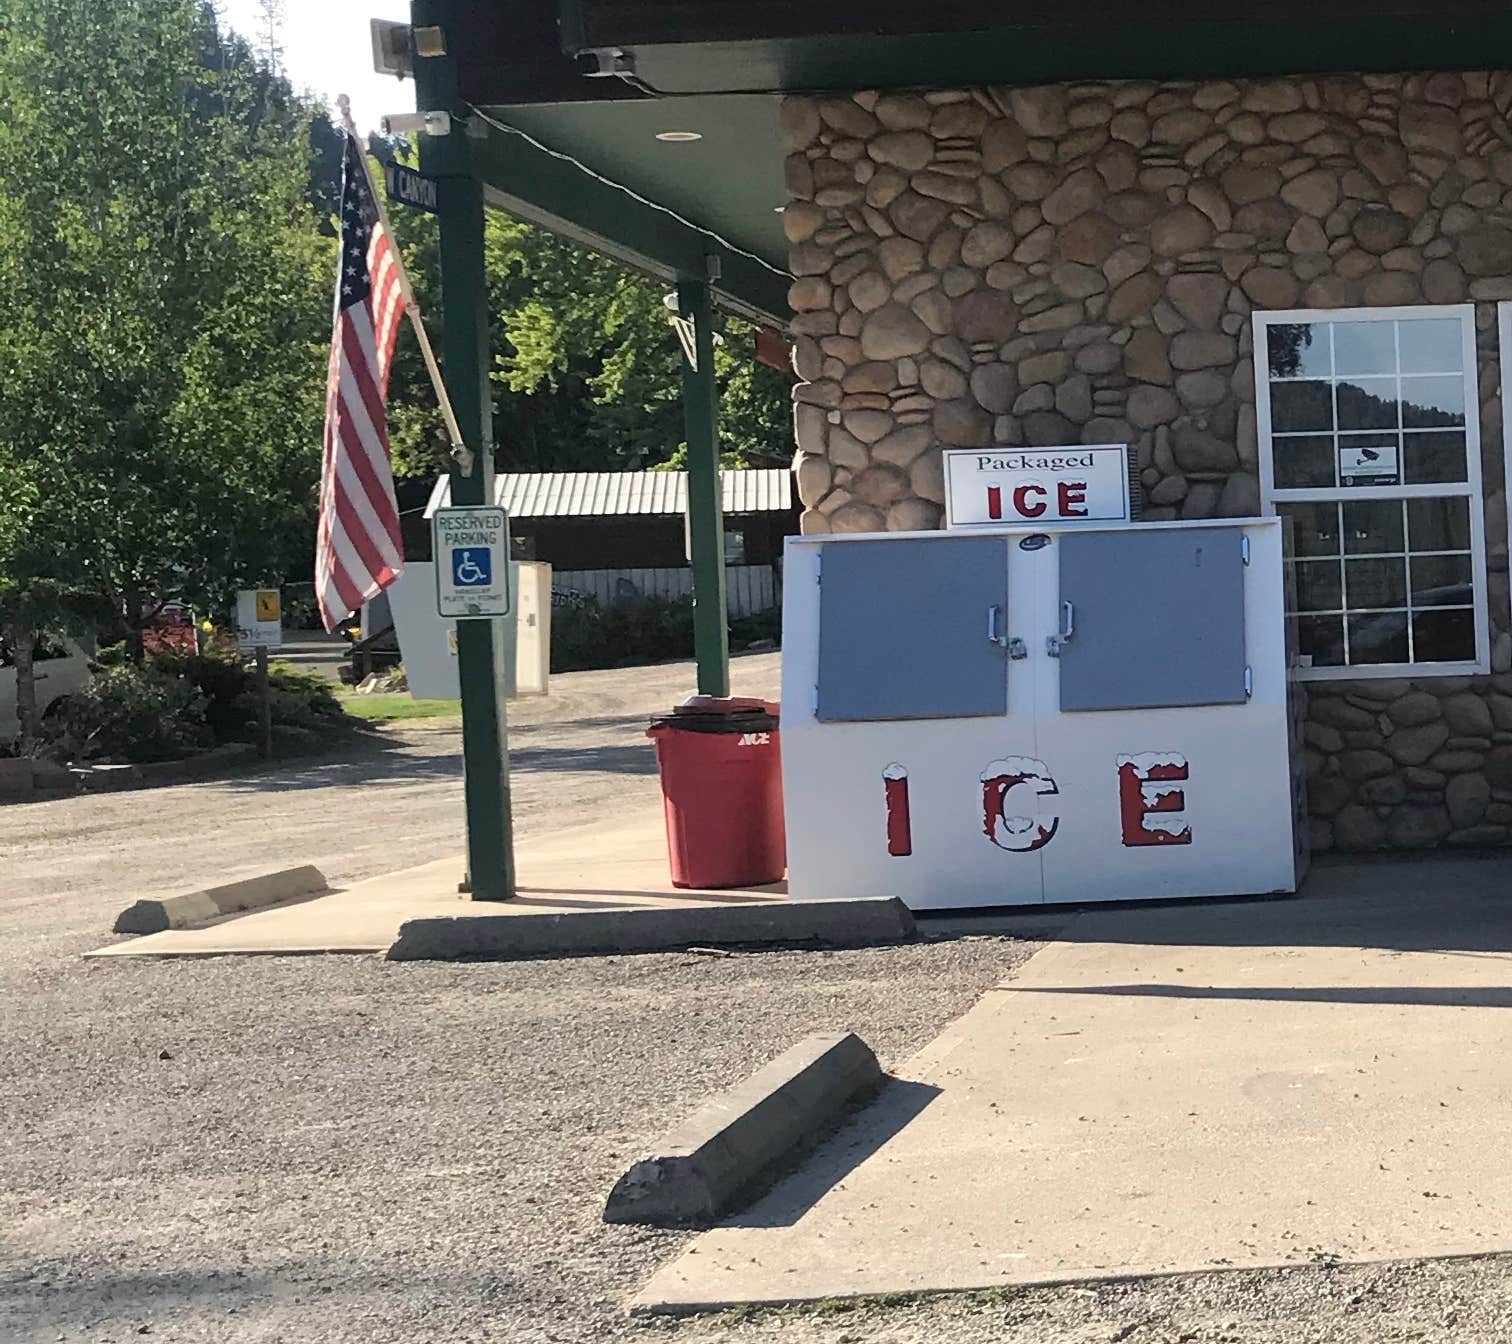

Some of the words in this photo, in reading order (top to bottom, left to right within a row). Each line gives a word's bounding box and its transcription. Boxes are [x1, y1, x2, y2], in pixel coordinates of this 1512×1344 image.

[399, 170, 438, 208] CANYON
[976, 452, 1095, 472] Packaged
[986, 480, 1090, 520] ICE
[439, 515, 501, 530] RESERVED
[444, 531, 497, 545] PARKING
[737, 732, 770, 746] ACE
[881, 751, 1193, 857] ICE
